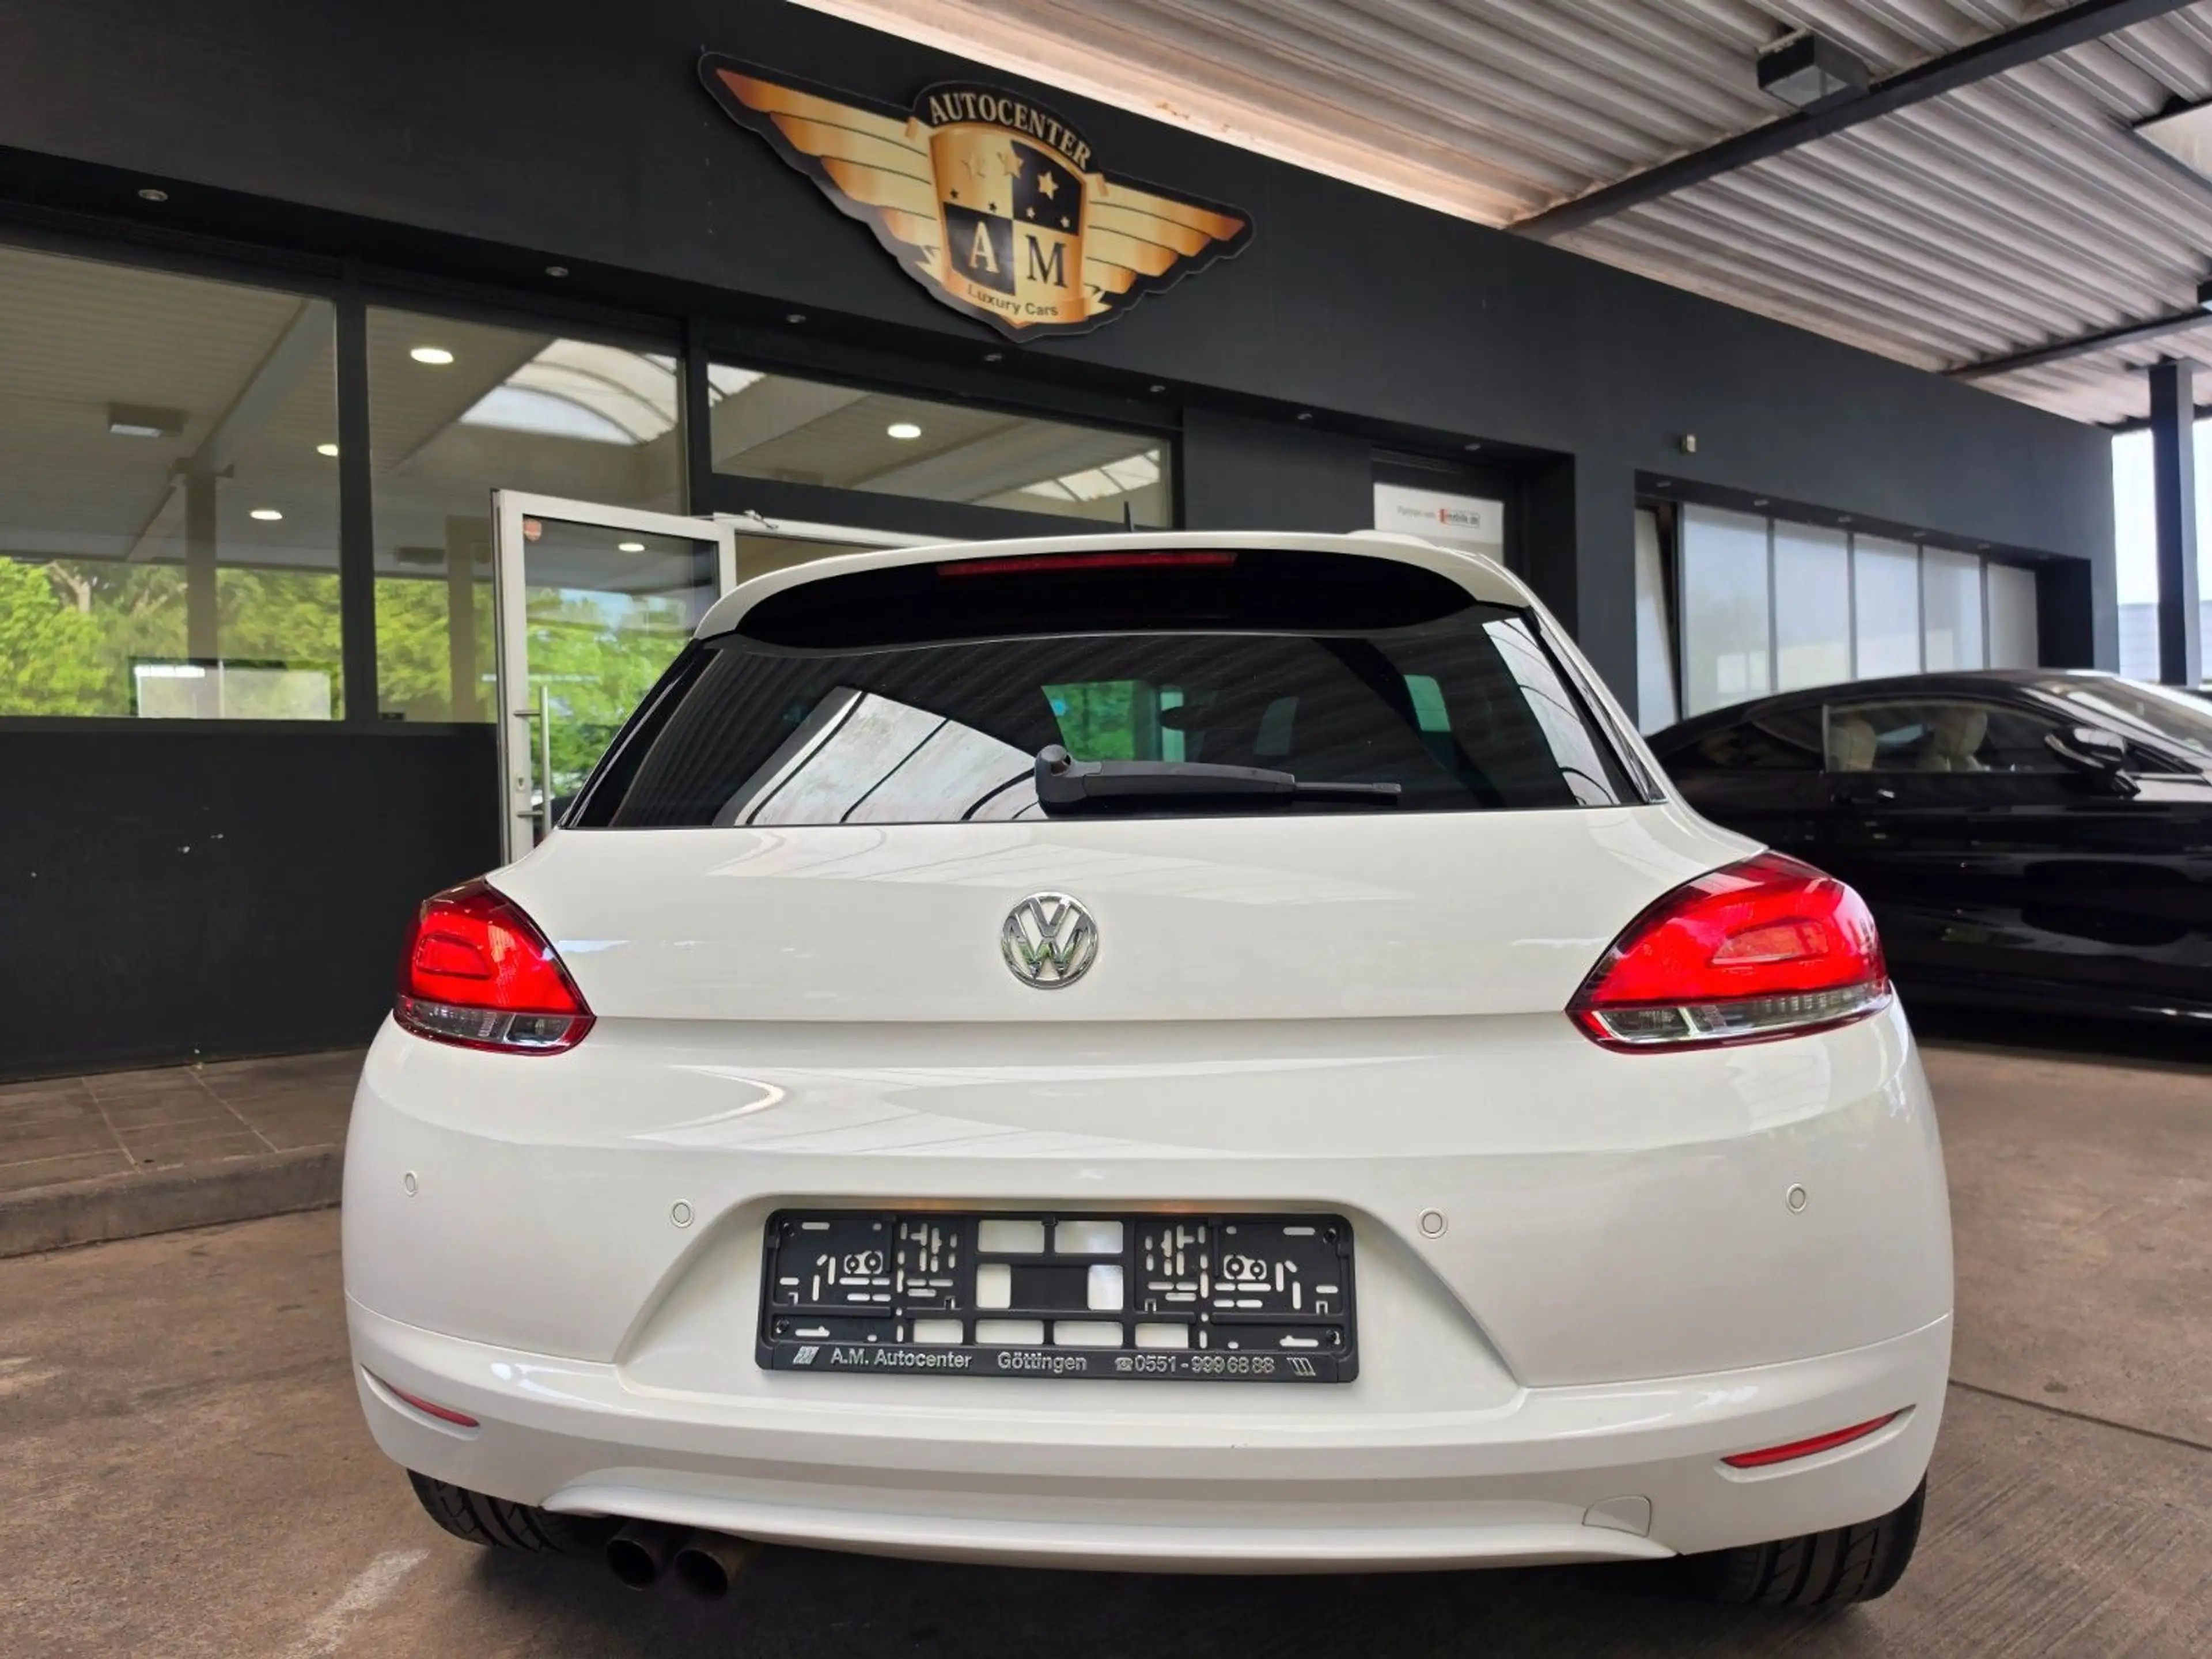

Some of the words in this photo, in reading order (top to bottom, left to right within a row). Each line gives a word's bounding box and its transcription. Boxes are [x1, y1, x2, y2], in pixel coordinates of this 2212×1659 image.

[928, 92, 1092, 172] AUTOCENTER
[968, 221, 999, 274] A
[1025, 233, 1068, 289] M
[967, 283, 1021, 316] Luxury
[1024, 302, 1059, 317] Cars
[830, 1347, 869, 1366] A.M.
[874, 1349, 972, 1368] Autocenter
[998, 1351, 1088, 1374] Göttingen
